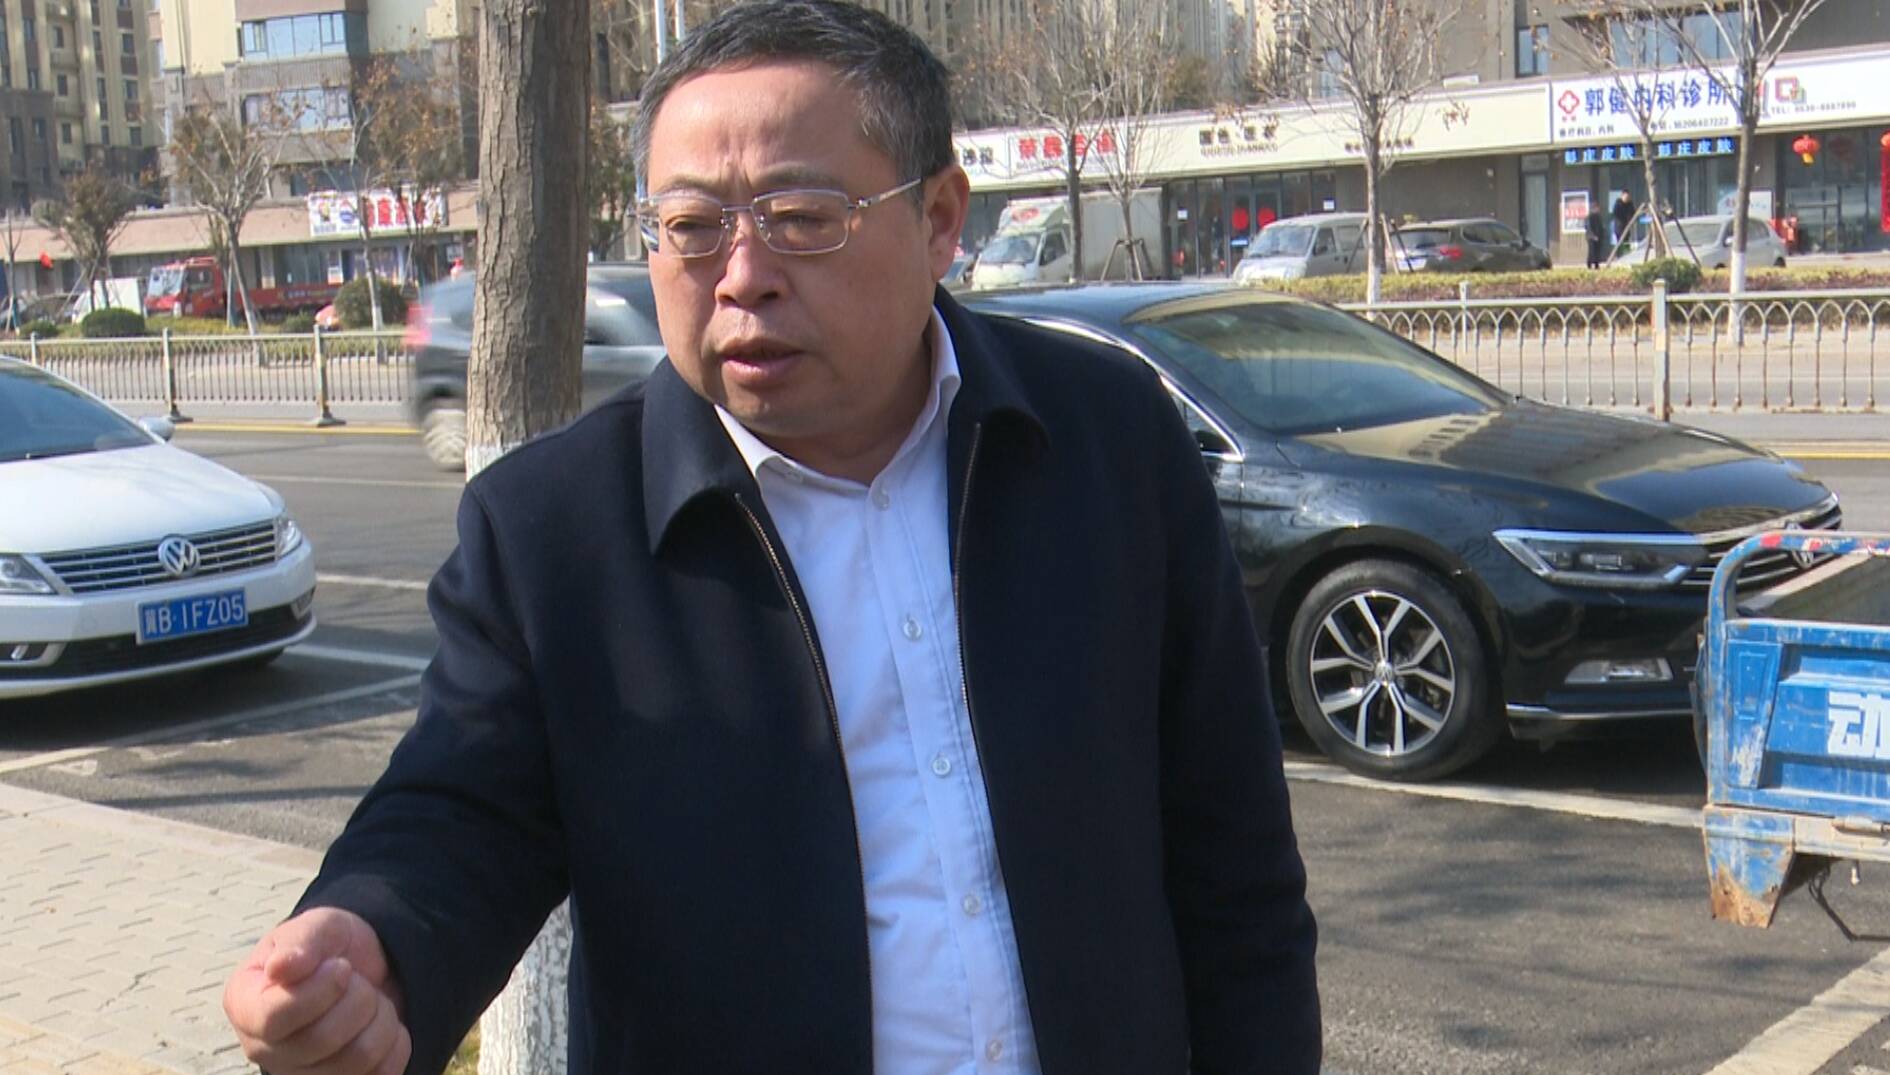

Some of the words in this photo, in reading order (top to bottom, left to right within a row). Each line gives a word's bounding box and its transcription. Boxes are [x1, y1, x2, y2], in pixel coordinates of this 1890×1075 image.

[1584, 79, 1729, 117] 郭健内科诊所
[1828, 690, 1890, 759] 动
